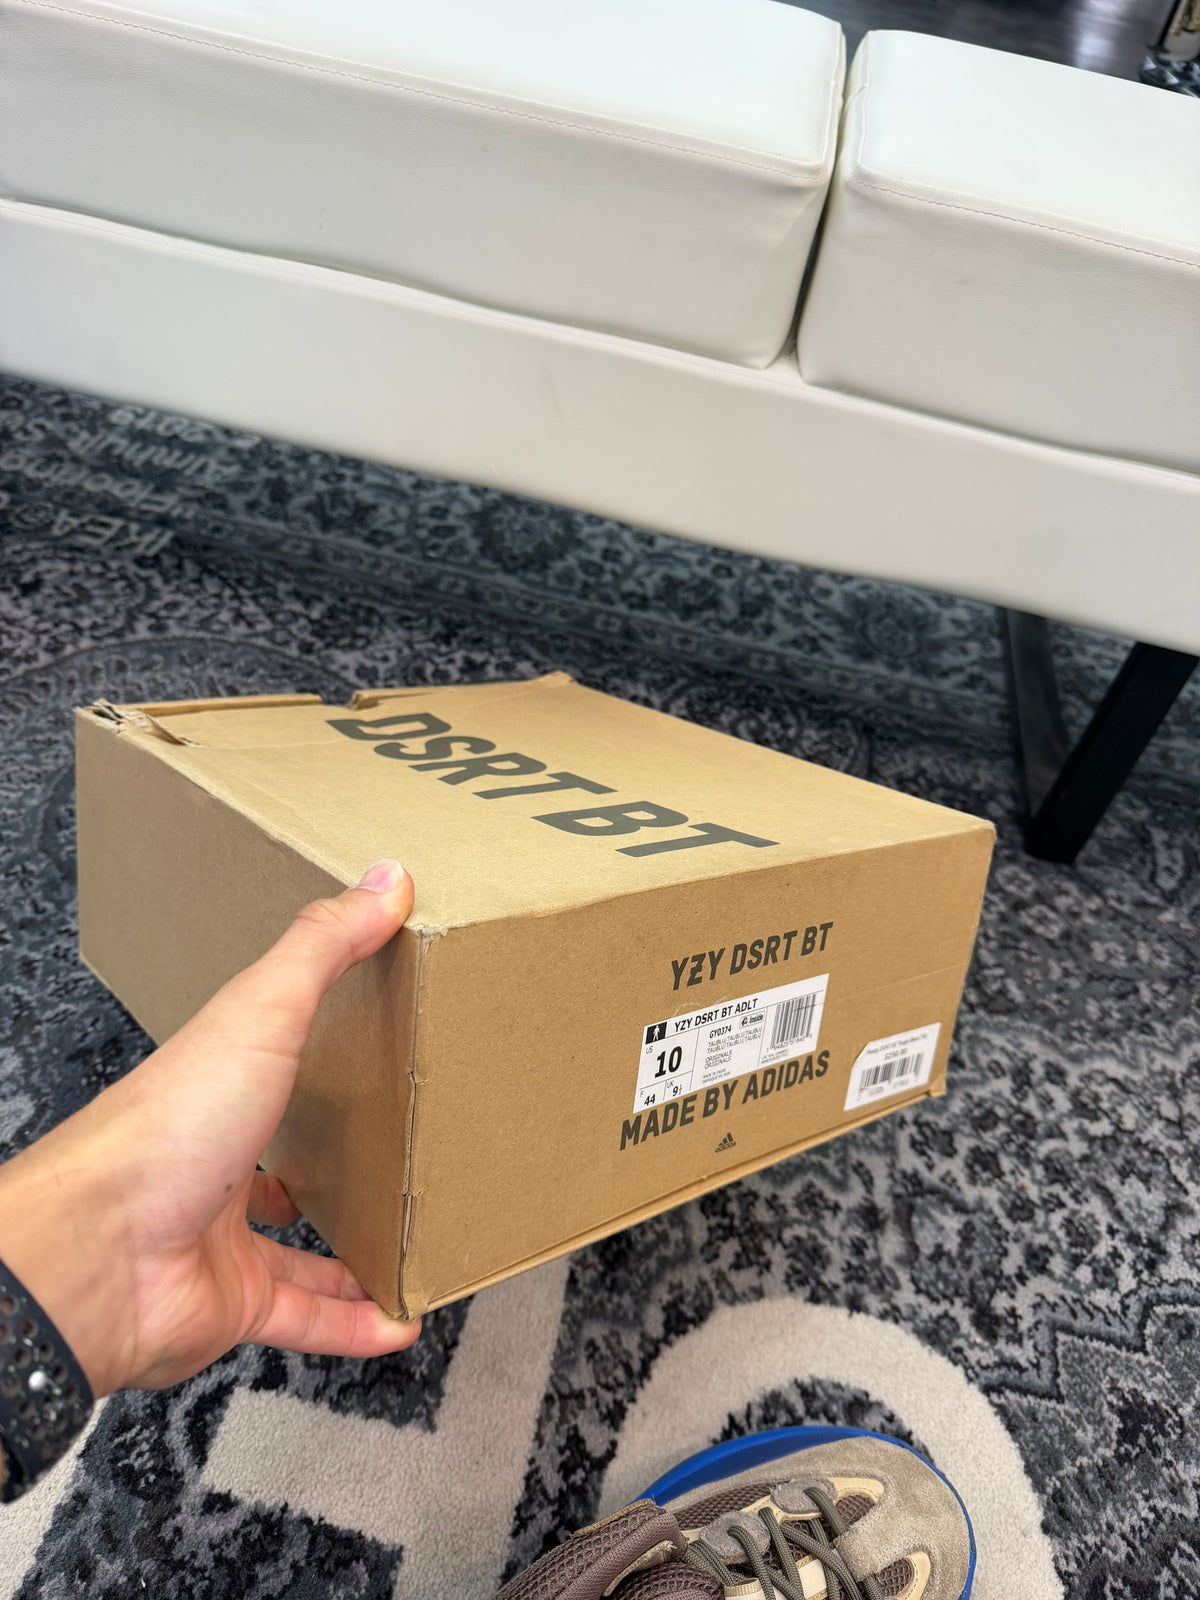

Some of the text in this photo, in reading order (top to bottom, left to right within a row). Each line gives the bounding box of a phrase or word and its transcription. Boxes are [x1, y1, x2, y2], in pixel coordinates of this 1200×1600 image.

[325, 712, 781, 858] DSRT BT
[671, 921, 834, 991] YZY DSRT BT
[674, 998, 758, 1032] YZY DSRT BT ADLT
[645, 1045, 654, 1055] US
[654, 1045, 683, 1078] 10
[620, 1050, 830, 1151] MADE BY ADIDAS
[643, 1094, 656, 1106] 44
[666, 1080, 675, 1089] UK
